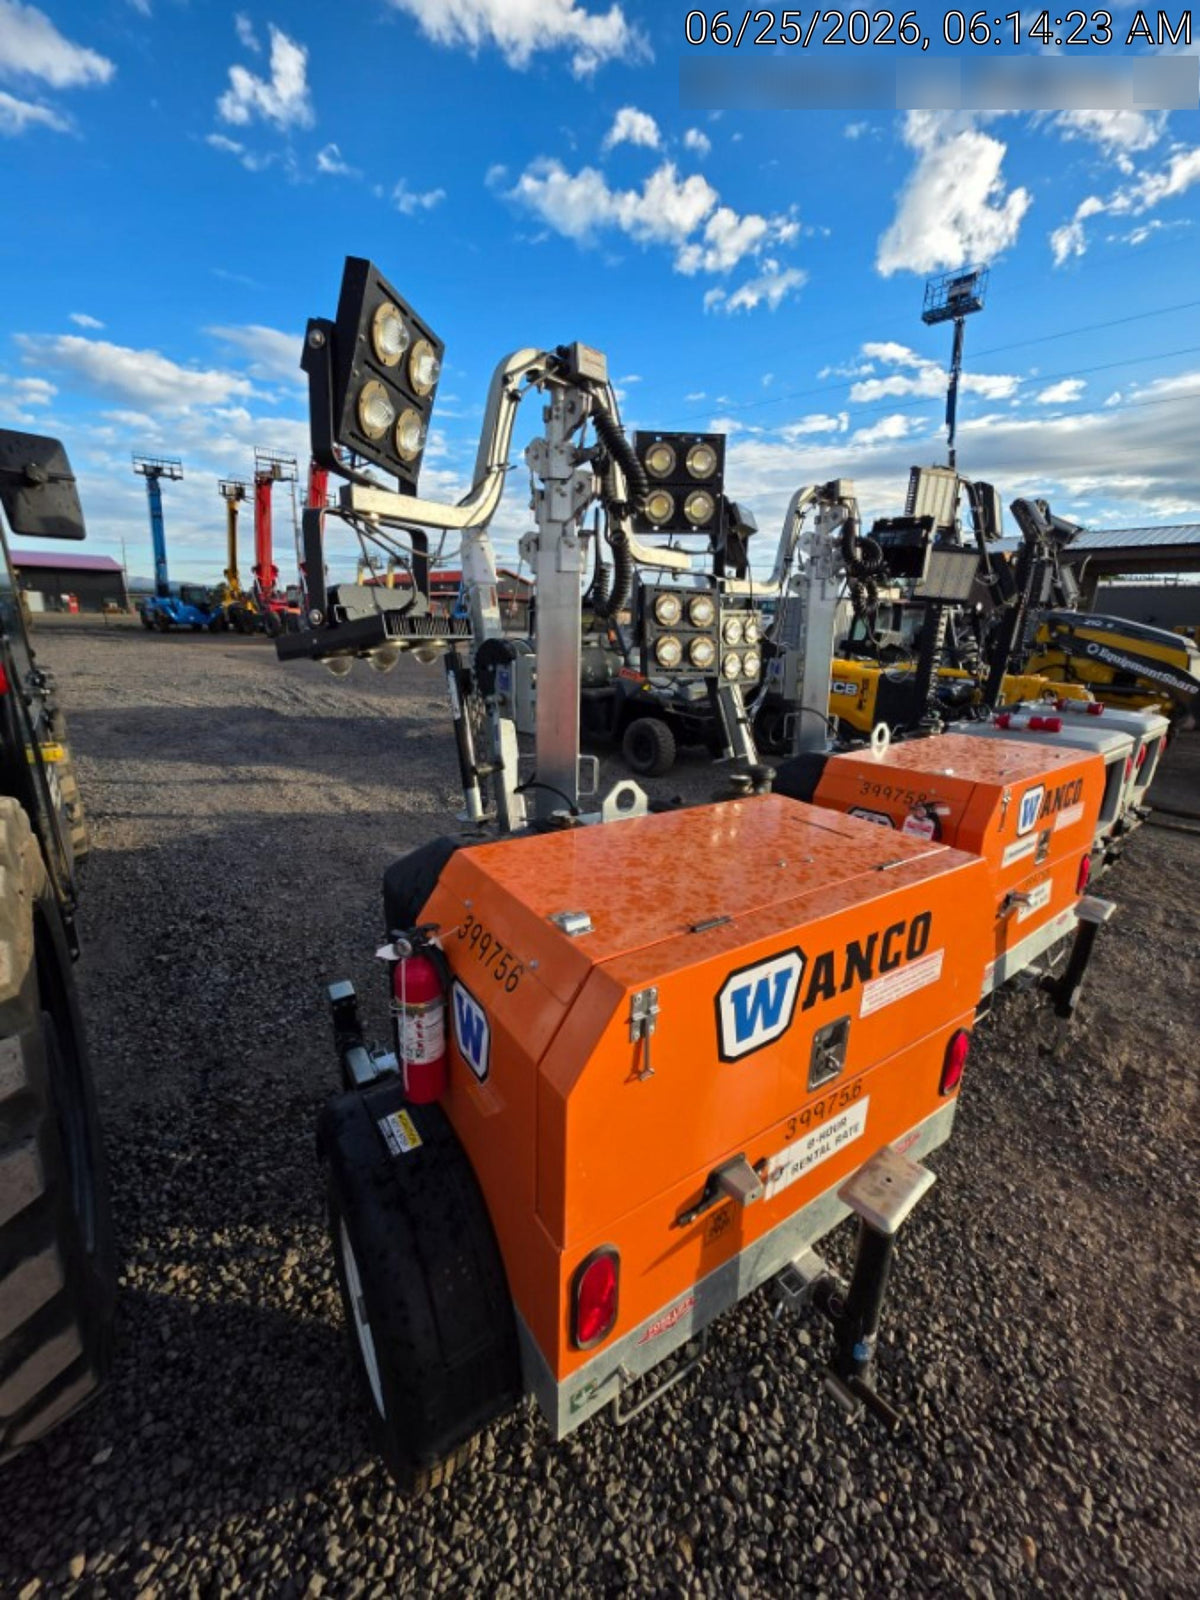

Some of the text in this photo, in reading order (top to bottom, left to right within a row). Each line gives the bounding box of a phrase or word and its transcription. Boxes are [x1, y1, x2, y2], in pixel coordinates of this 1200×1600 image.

[1098, 647, 1199, 694] EquipmentShare
[1021, 778, 1083, 829] WANCO
[458, 914, 524, 993] 399756
[730, 911, 932, 1044] WANCO
[785, 1078, 862, 1140] 399756
[791, 1121, 860, 1175] RENTAL RATE
